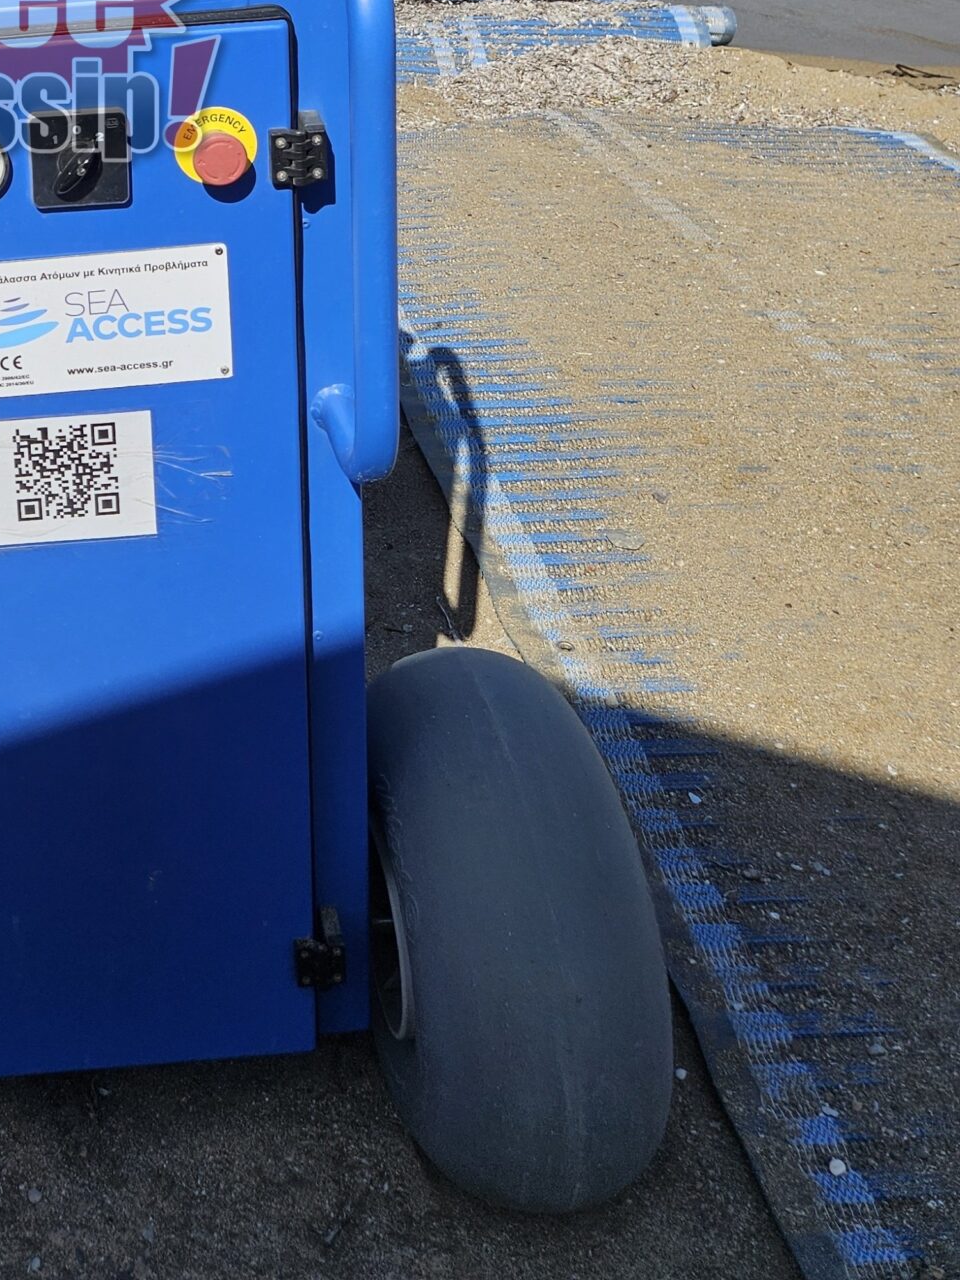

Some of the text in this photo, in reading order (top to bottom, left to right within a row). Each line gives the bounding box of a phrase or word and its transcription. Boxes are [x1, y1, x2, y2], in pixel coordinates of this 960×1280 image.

[95, 132, 105, 142] 2
[183, 113, 247, 141] EMERGENCY
[40, 270, 80, 281] Ατόμων
[83, 270, 95, 280] με
[98, 265, 141, 276] Κινητικά
[144, 259, 208, 273] Προβλήματα
[64, 289, 130, 317] SEA
[66, 306, 213, 344] ACCESS
[67, 359, 174, 375] www.sea-access.gr
